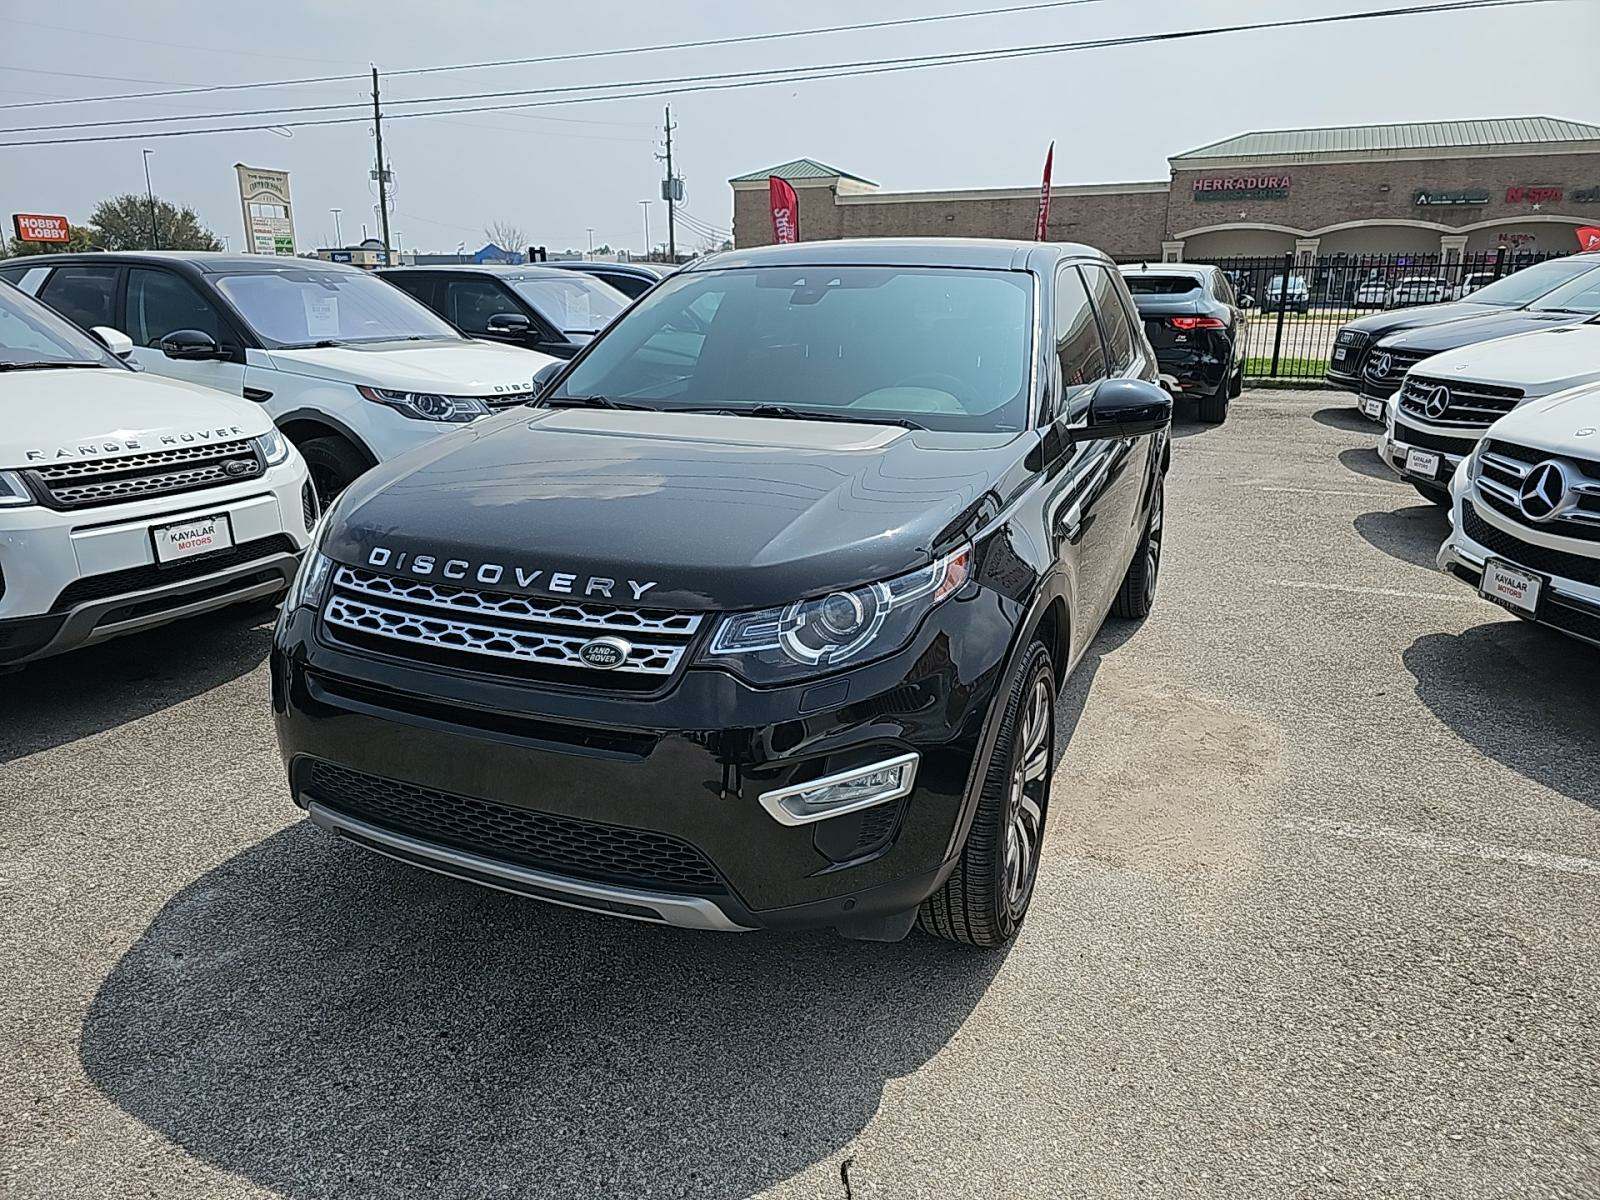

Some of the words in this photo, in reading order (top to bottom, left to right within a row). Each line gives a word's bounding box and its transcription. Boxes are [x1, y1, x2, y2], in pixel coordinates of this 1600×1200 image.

[1192, 176, 1290, 191] HERRADURA
[20, 218, 60, 229] HOBBY
[28, 228, 67, 239] LOBBY
[25, 439, 141, 461] RANGE
[160, 425, 244, 445] ROVER
[1413, 455, 1432, 465] KAYALAR
[170, 525, 215, 542] KAYALAR
[178, 536, 212, 550] MOTORS
[368, 547, 658, 600] DISCOVERY
[1495, 573, 1528, 592] KAYALAR
[1497, 584, 1522, 599] MOTORS
[588, 646, 611, 655] LAND
[589, 654, 616, 663] ROVER
